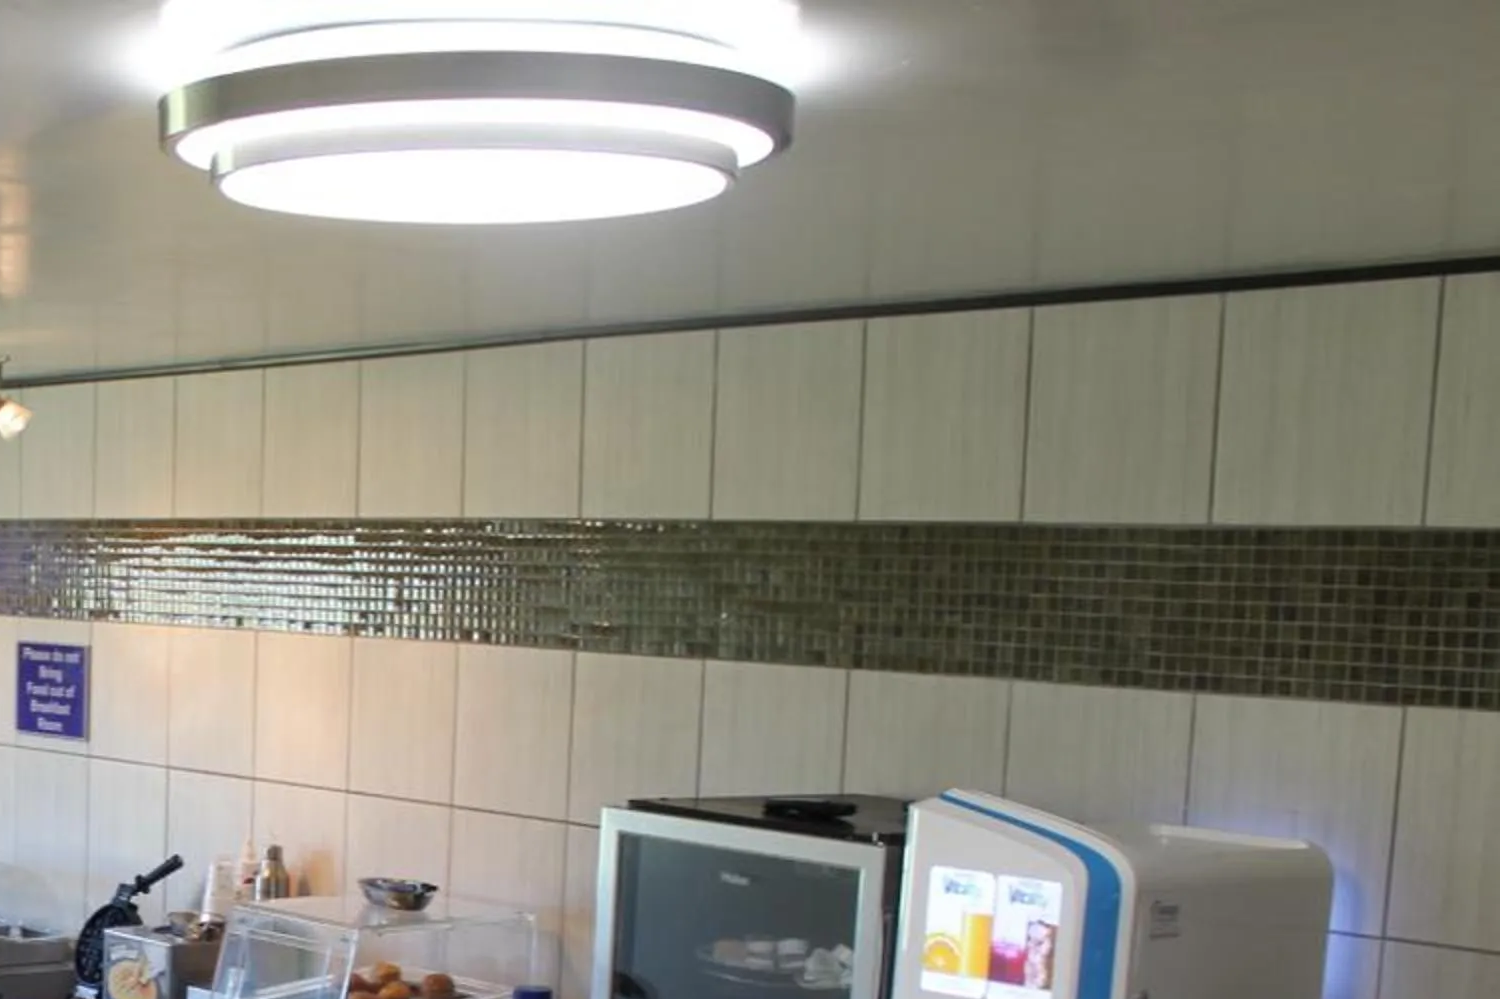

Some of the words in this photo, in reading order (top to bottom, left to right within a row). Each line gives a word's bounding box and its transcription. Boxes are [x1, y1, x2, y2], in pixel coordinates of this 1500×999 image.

[22, 647, 50, 661] Please
[52, 648, 64, 662] do
[65, 650, 81, 664] not
[26, 681, 49, 697] Food
[50, 685, 65, 698] out
[65, 685, 76, 698] of
[30, 699, 71, 715] Breakfast
[37, 716, 63, 732] Room
